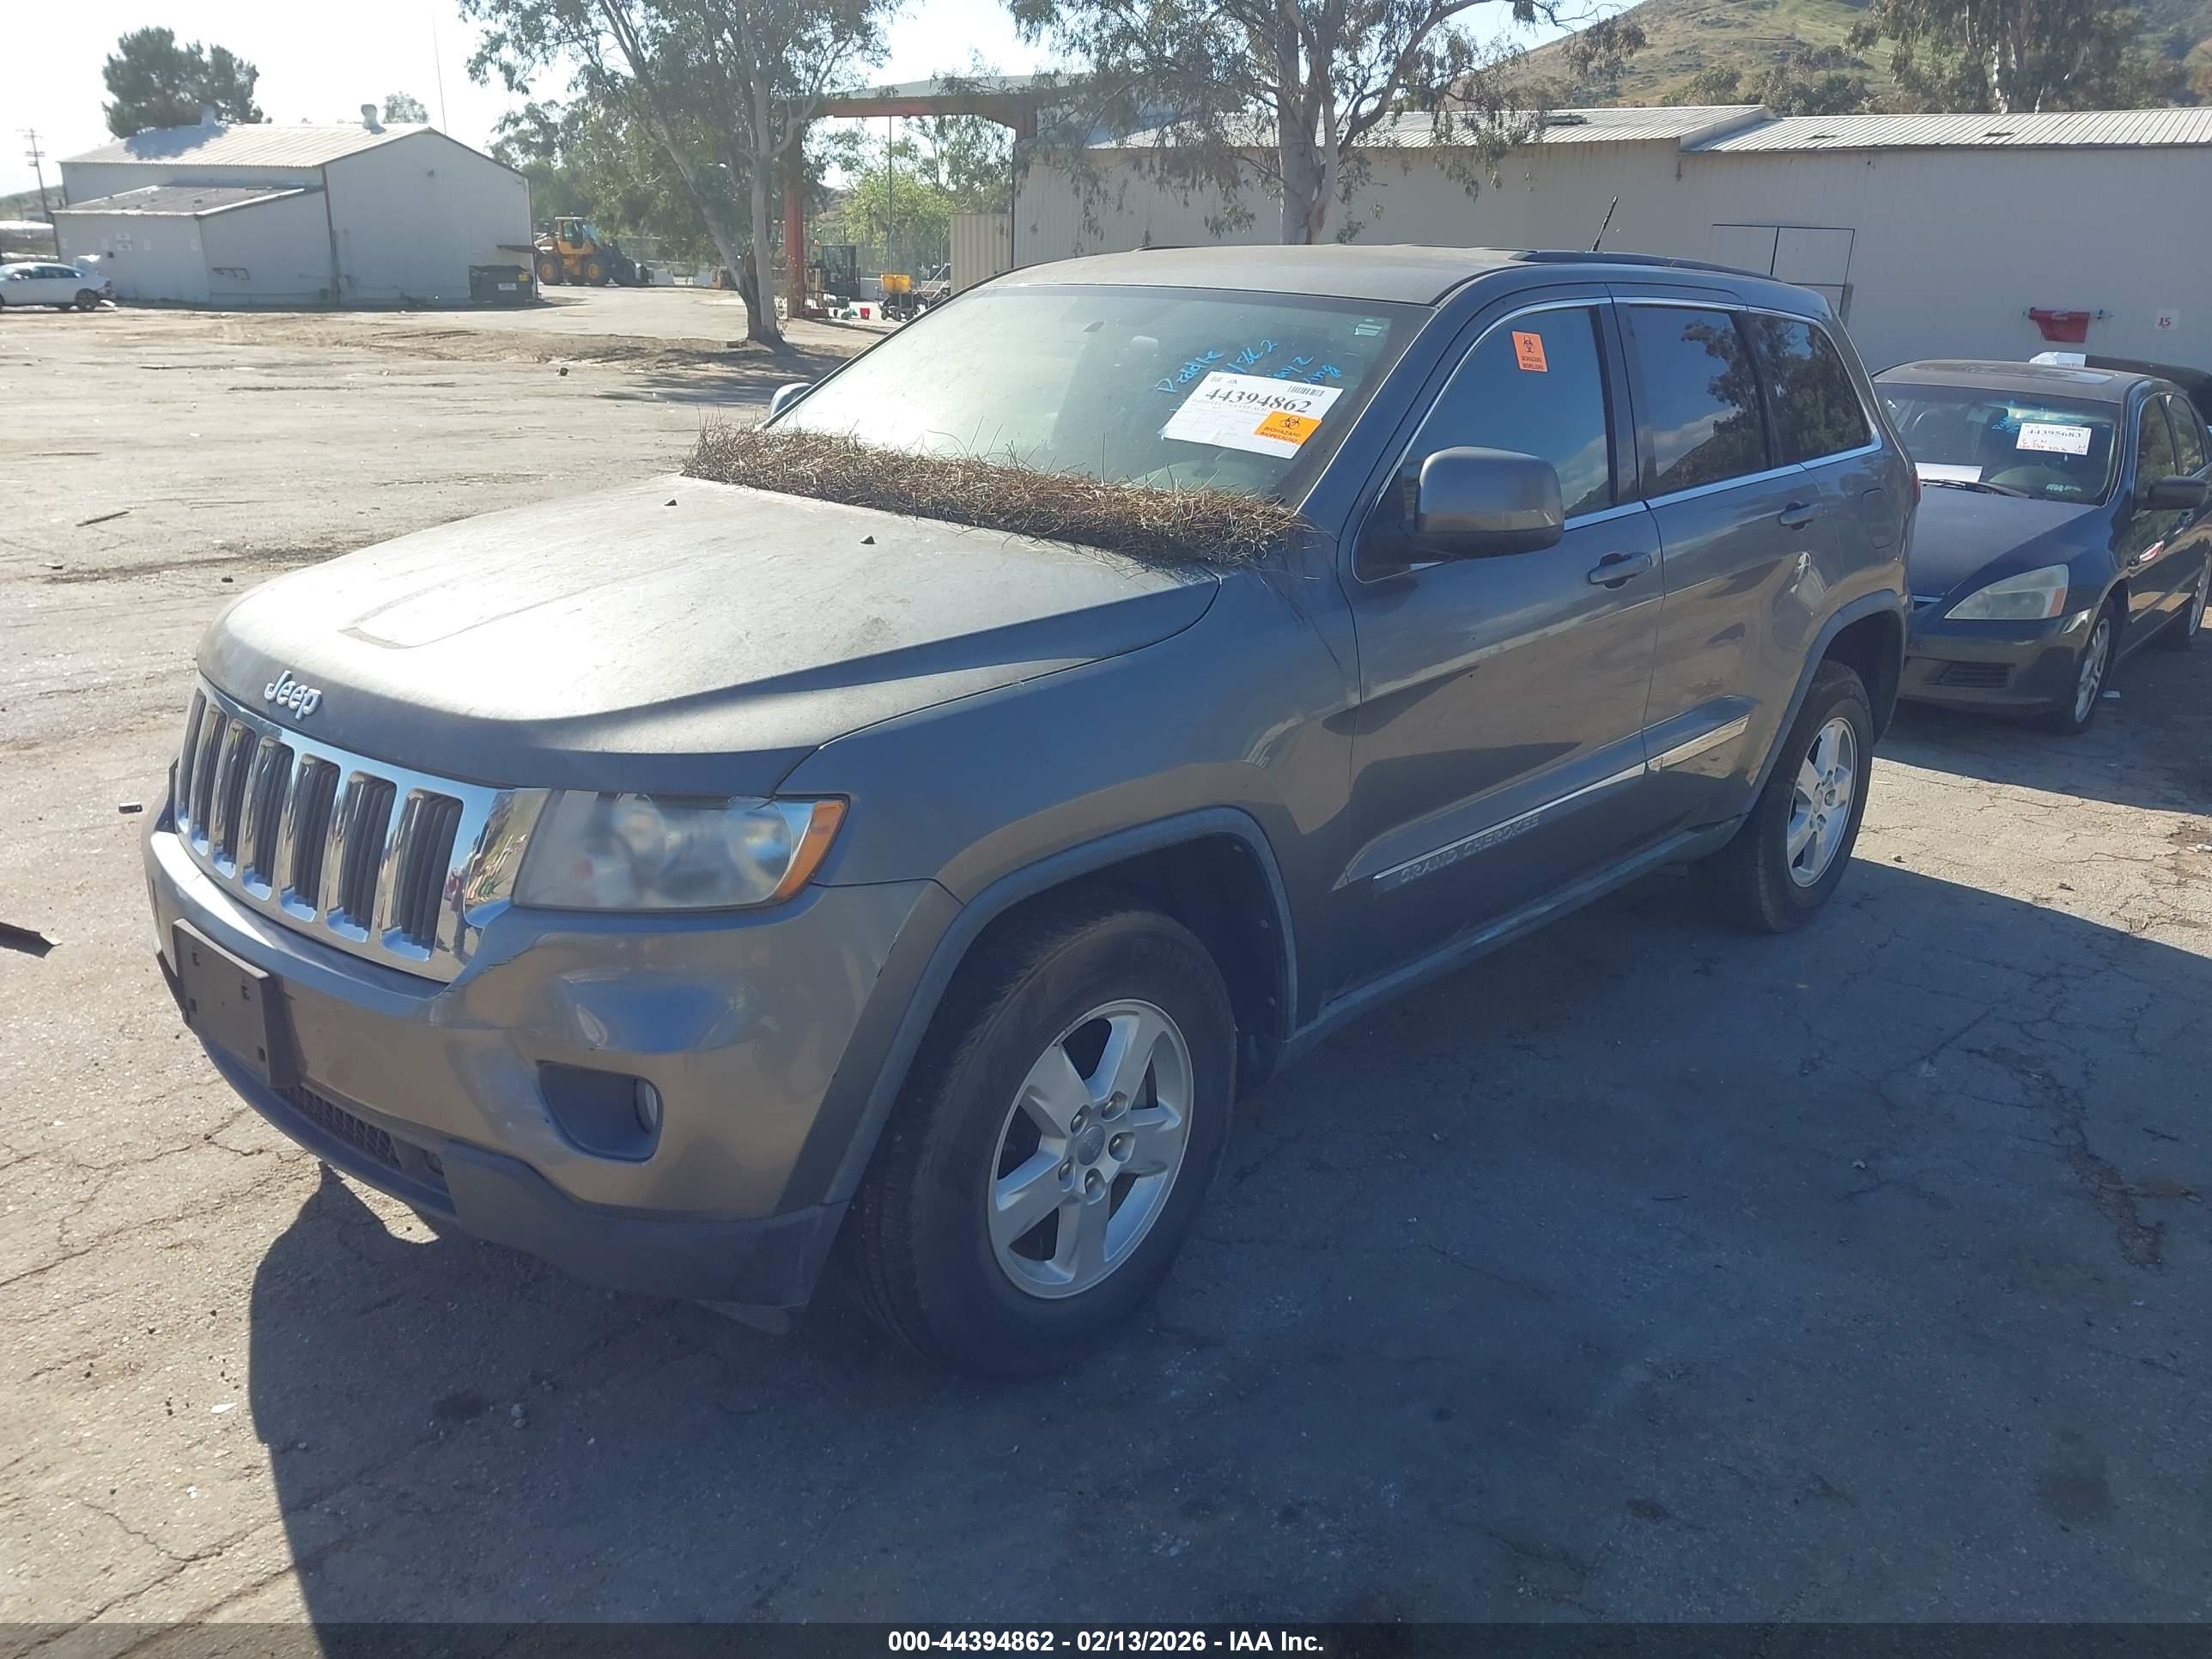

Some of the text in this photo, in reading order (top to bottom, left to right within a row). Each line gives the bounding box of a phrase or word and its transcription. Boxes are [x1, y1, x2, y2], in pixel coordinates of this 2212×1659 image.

[1206, 387, 1313, 414] 44394862
[1260, 431, 1297, 443] BIOPELIGRO
[1264, 426, 1302, 437] BIOHAZARD
[2027, 428, 2082, 439] 44395683
[264, 669, 322, 721] Jeep
[1400, 813, 1541, 884] GRAND CHEROKEE
